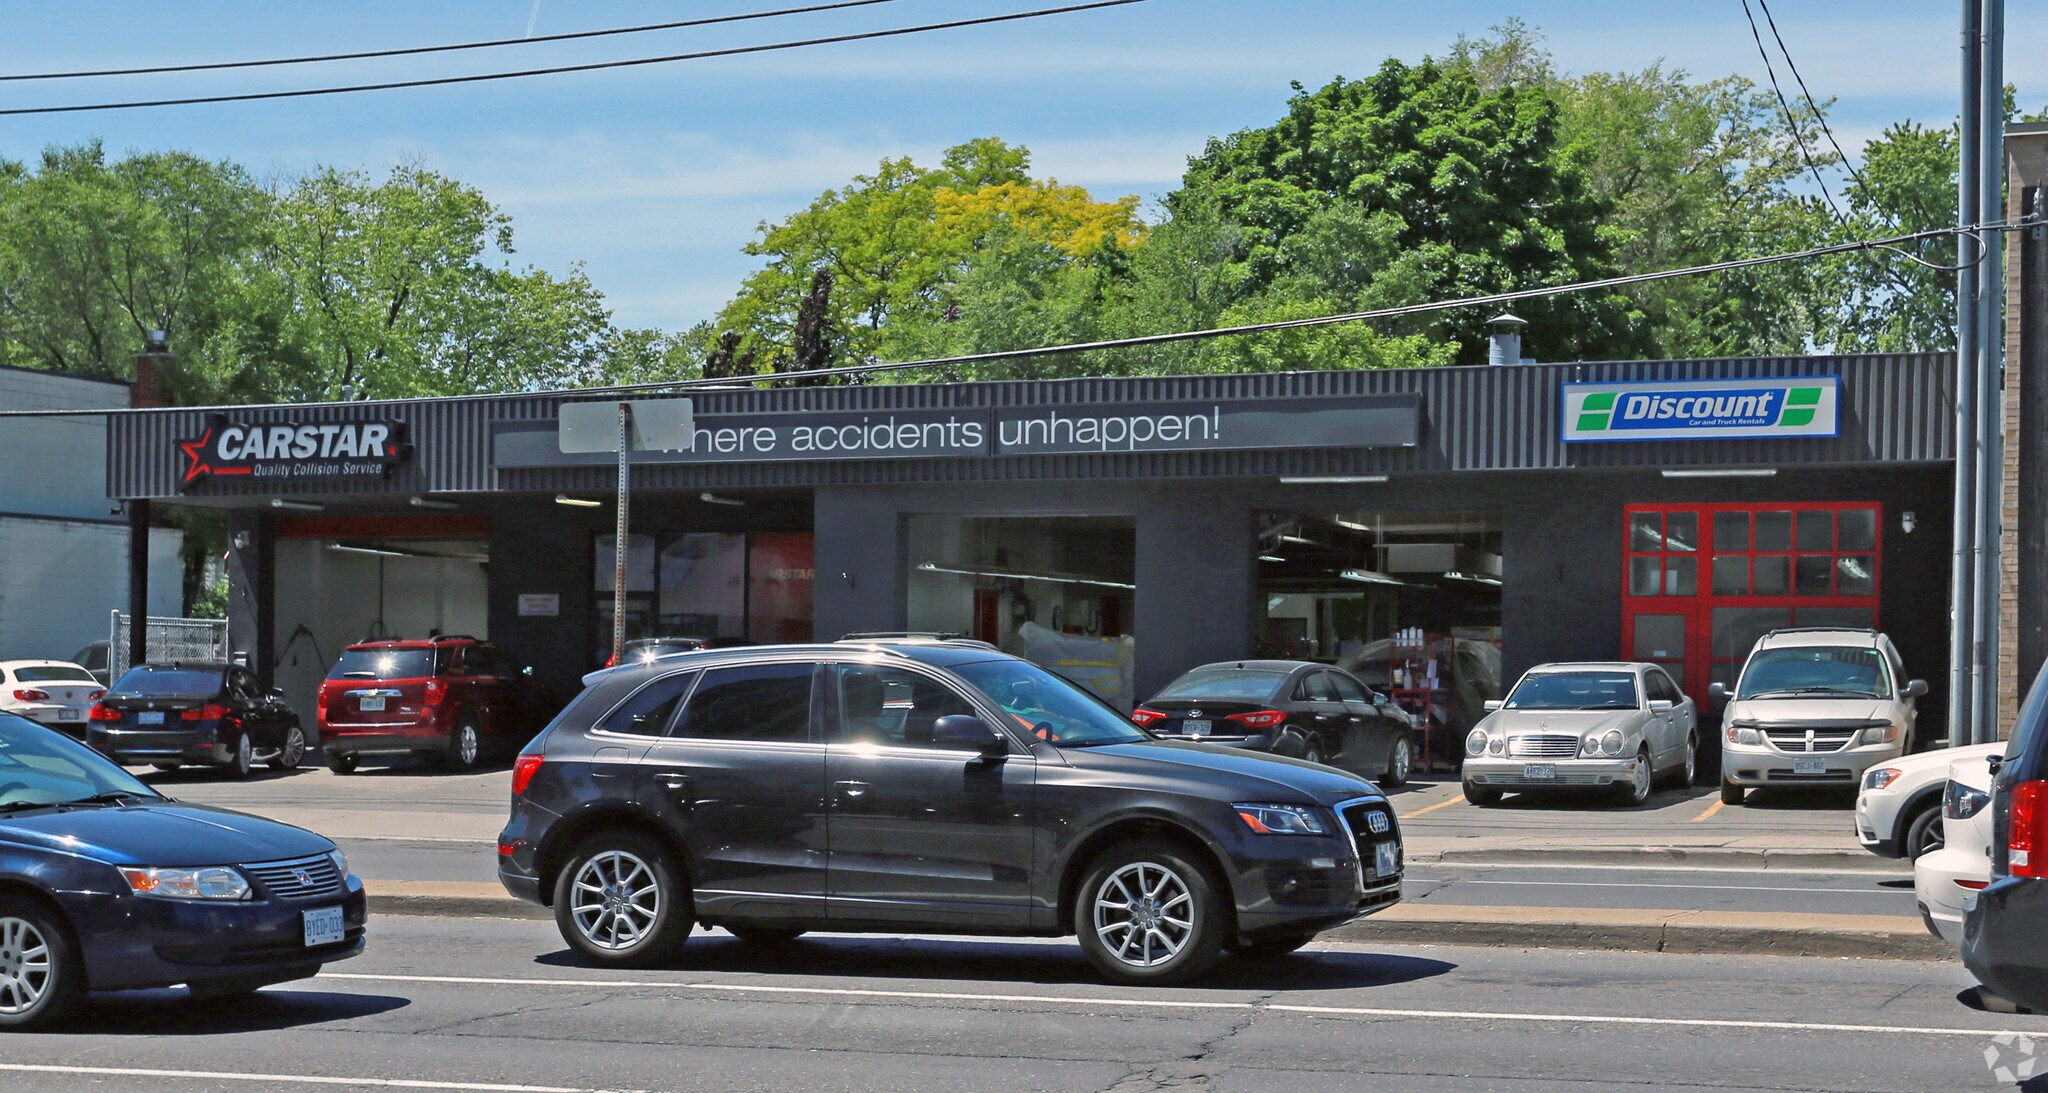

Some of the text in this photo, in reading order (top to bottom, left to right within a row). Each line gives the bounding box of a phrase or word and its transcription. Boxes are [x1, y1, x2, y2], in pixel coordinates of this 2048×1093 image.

[1624, 391, 1773, 420] Discount
[661, 405, 1220, 453] here accidents unhappen!
[1738, 417, 1765, 425] Rentals
[217, 424, 389, 461] CARSTAR
[254, 461, 382, 478] Quality Collision Service
